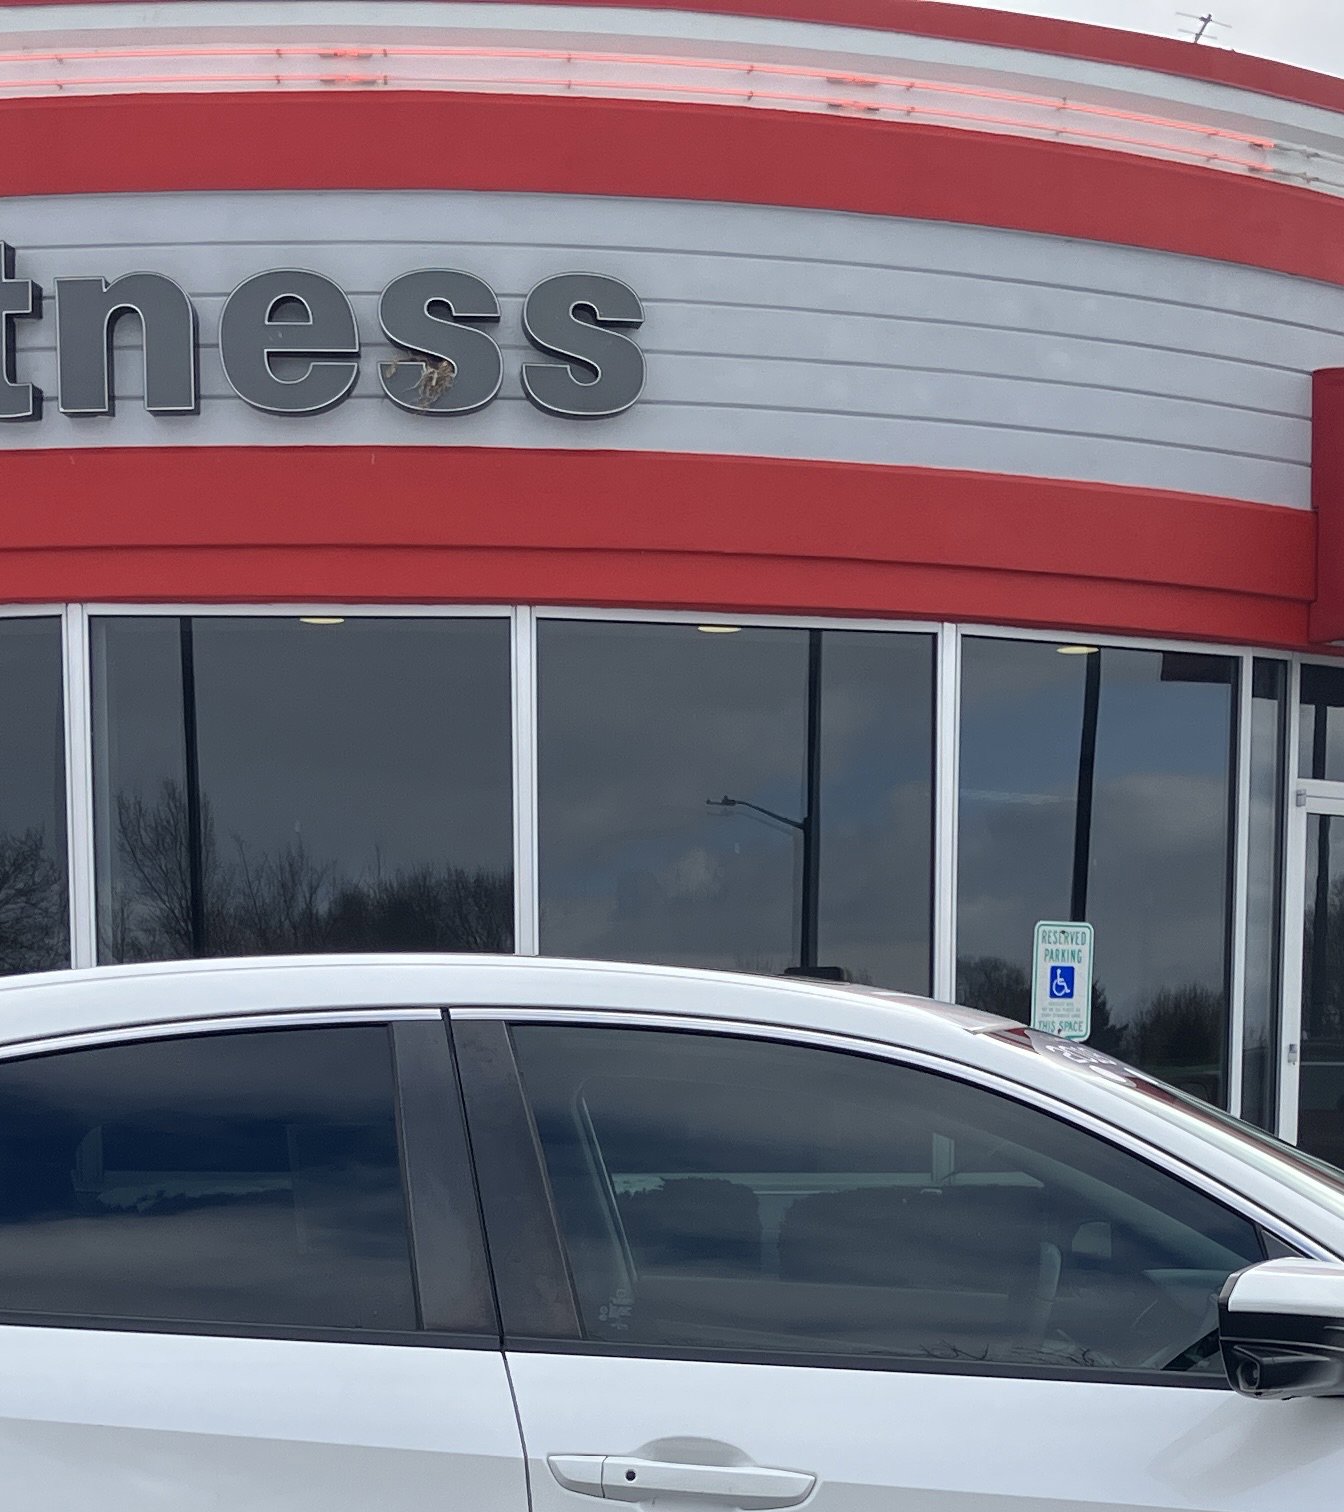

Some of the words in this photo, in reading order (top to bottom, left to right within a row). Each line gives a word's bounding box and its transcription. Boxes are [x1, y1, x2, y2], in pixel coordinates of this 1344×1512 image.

[1041, 929, 1087, 946] RESERVED
[1043, 948, 1083, 963] PARKING
[1038, 1020, 1056, 1033] THIS
[1058, 1020, 1084, 1033] SPACE
